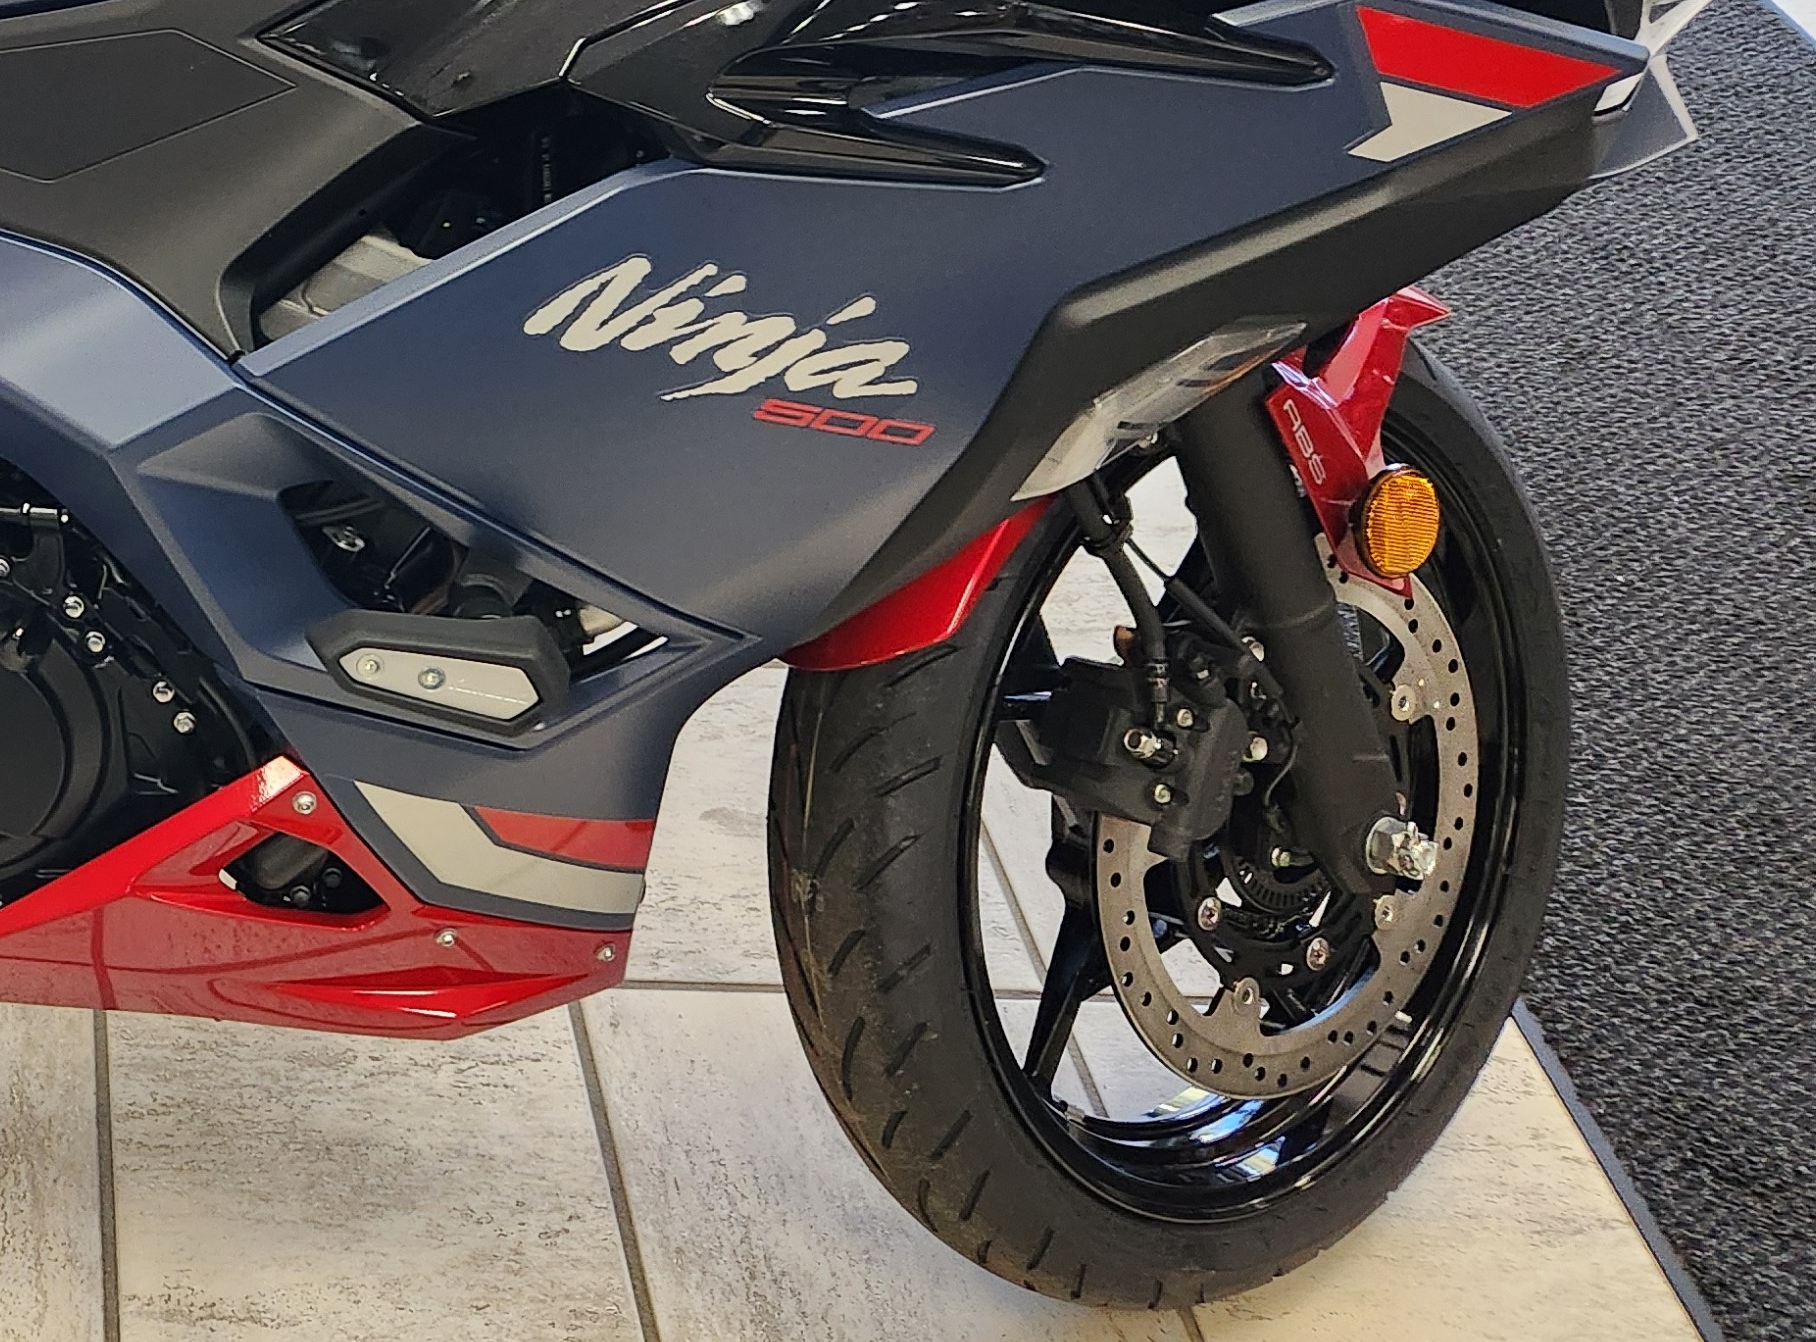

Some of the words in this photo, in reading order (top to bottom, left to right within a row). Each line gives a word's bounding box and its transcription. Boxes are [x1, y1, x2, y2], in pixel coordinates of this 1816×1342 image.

[522, 256, 918, 401] Ninja
[753, 399, 935, 446] 500
[1282, 398, 1327, 486] ABS
